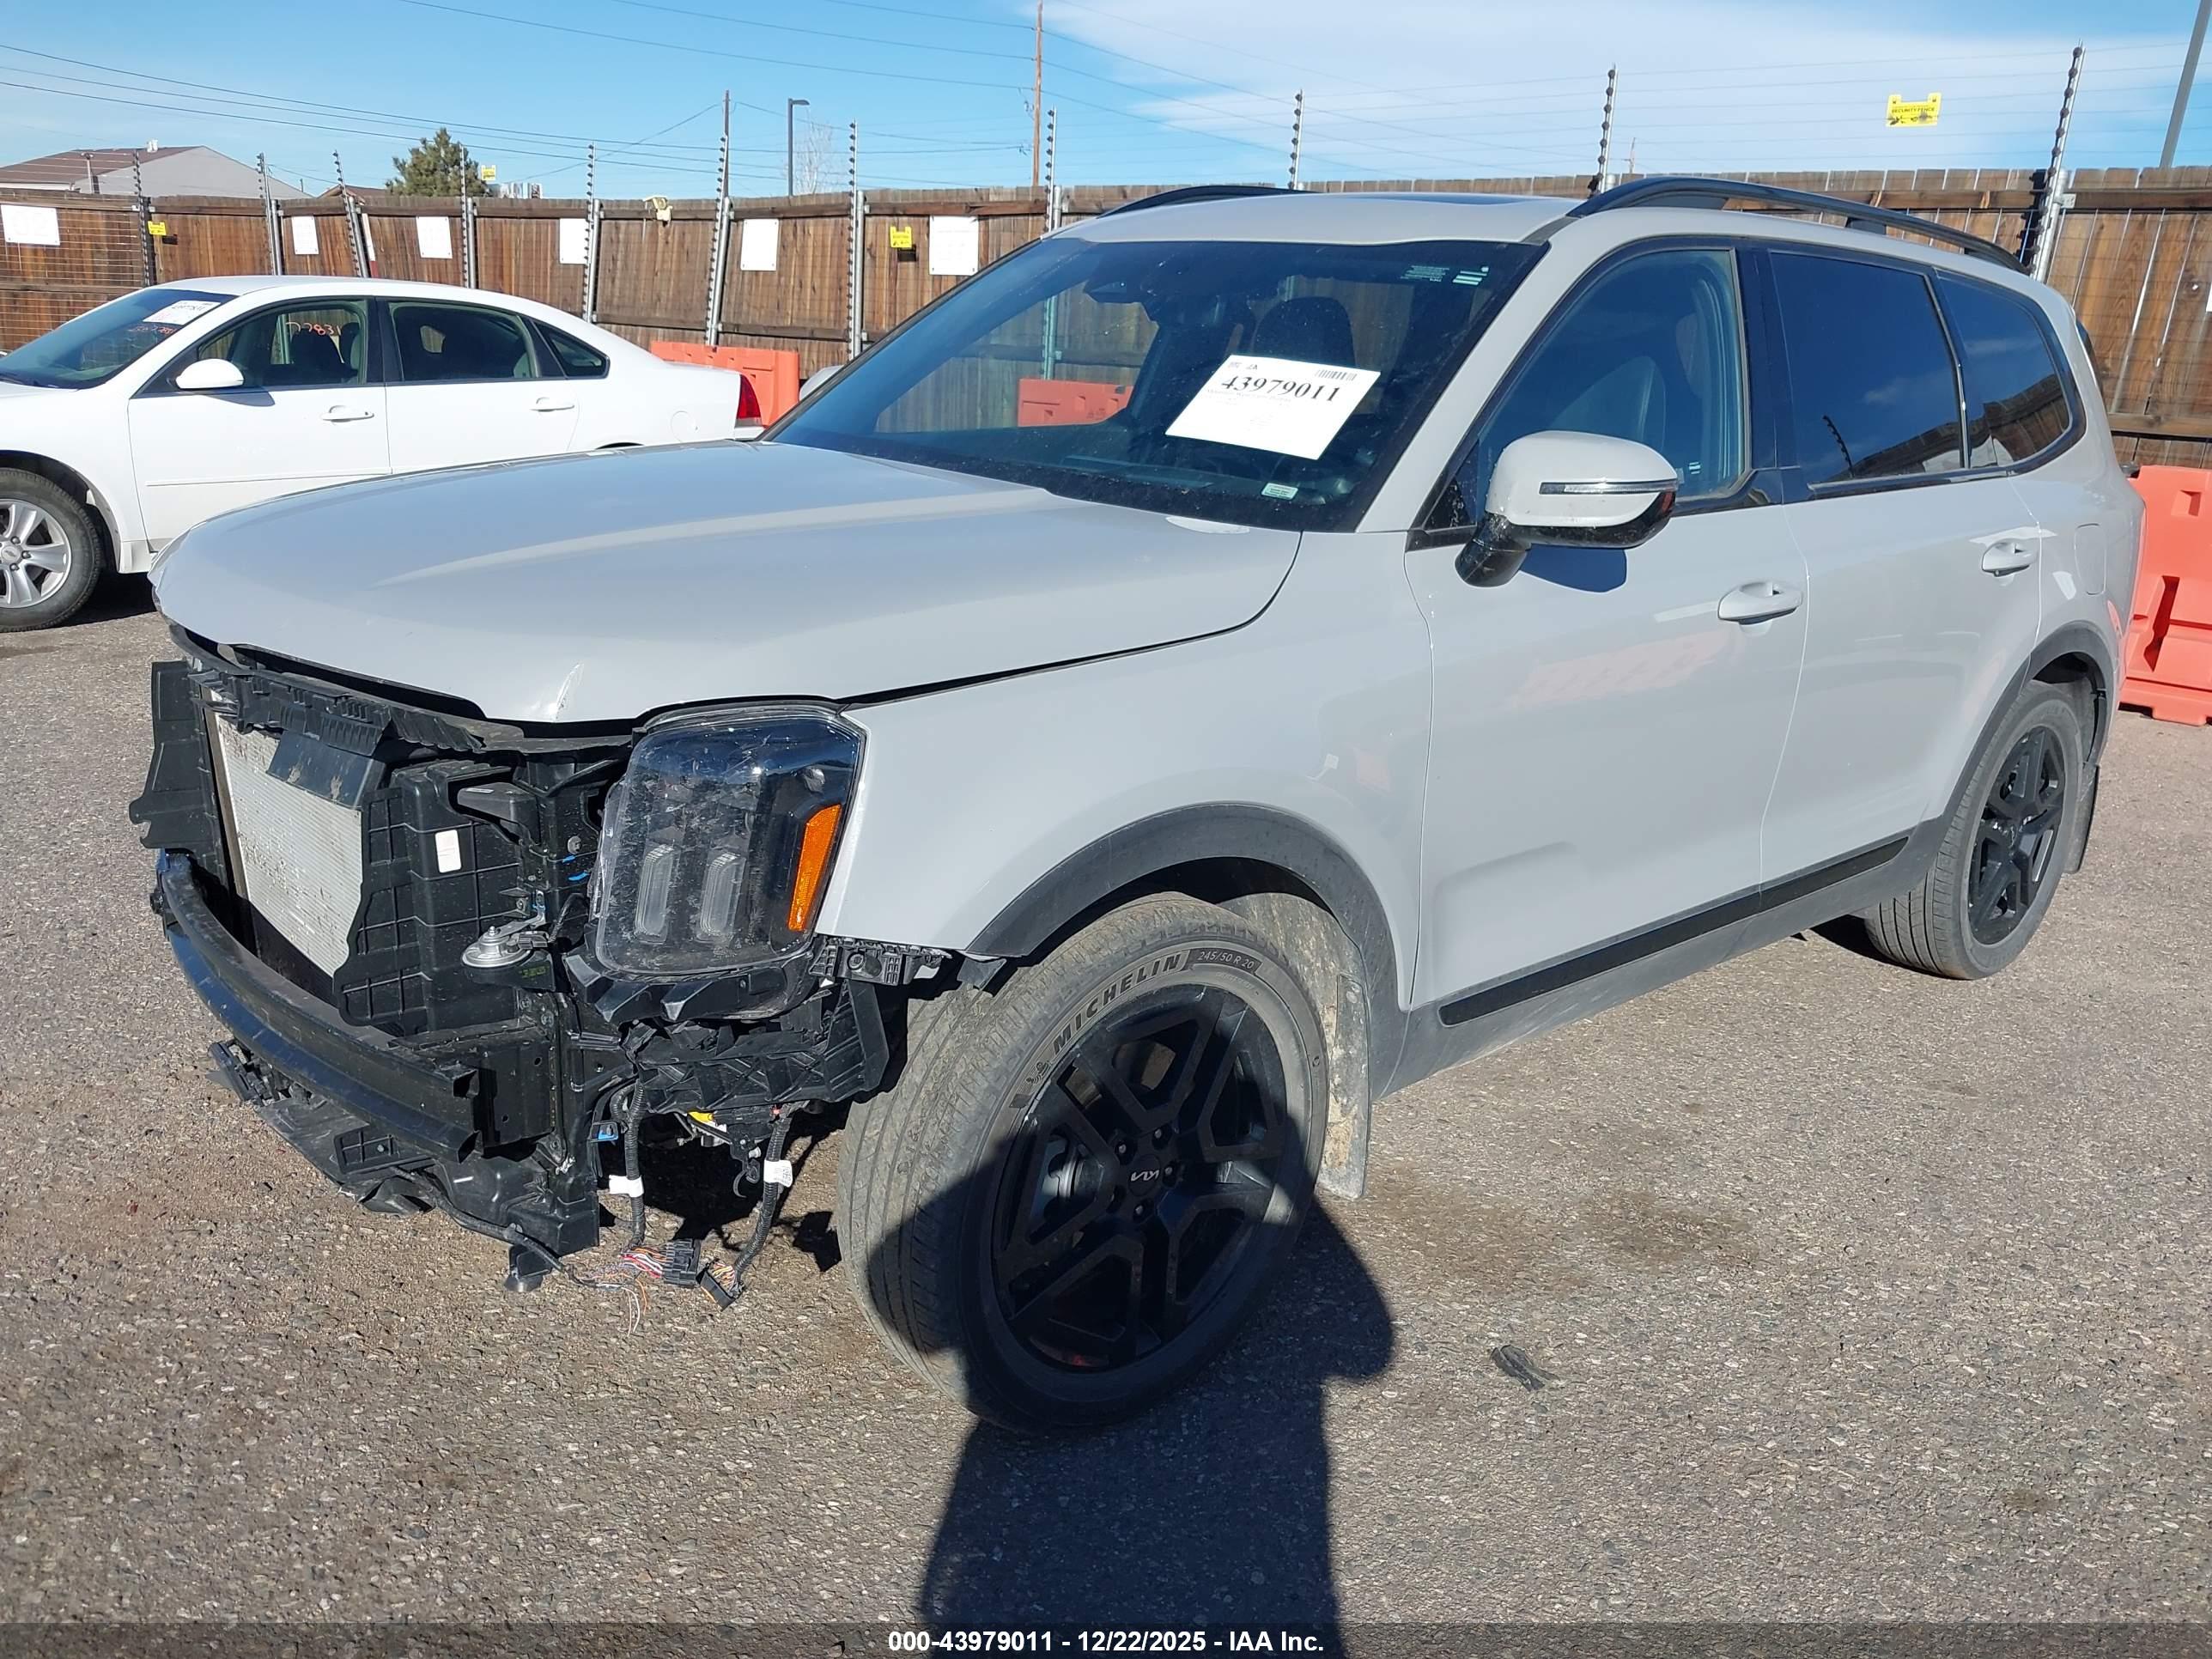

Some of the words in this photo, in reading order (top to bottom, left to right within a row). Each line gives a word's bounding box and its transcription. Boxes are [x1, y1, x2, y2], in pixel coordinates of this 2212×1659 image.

[1221, 375, 1340, 402] 43979011
[1197, 950, 1233, 963] 245/50
[1232, 955, 1243, 965] R
[1242, 958, 1255, 969] 20
[1054, 954, 1182, 1055] MICHELIN
